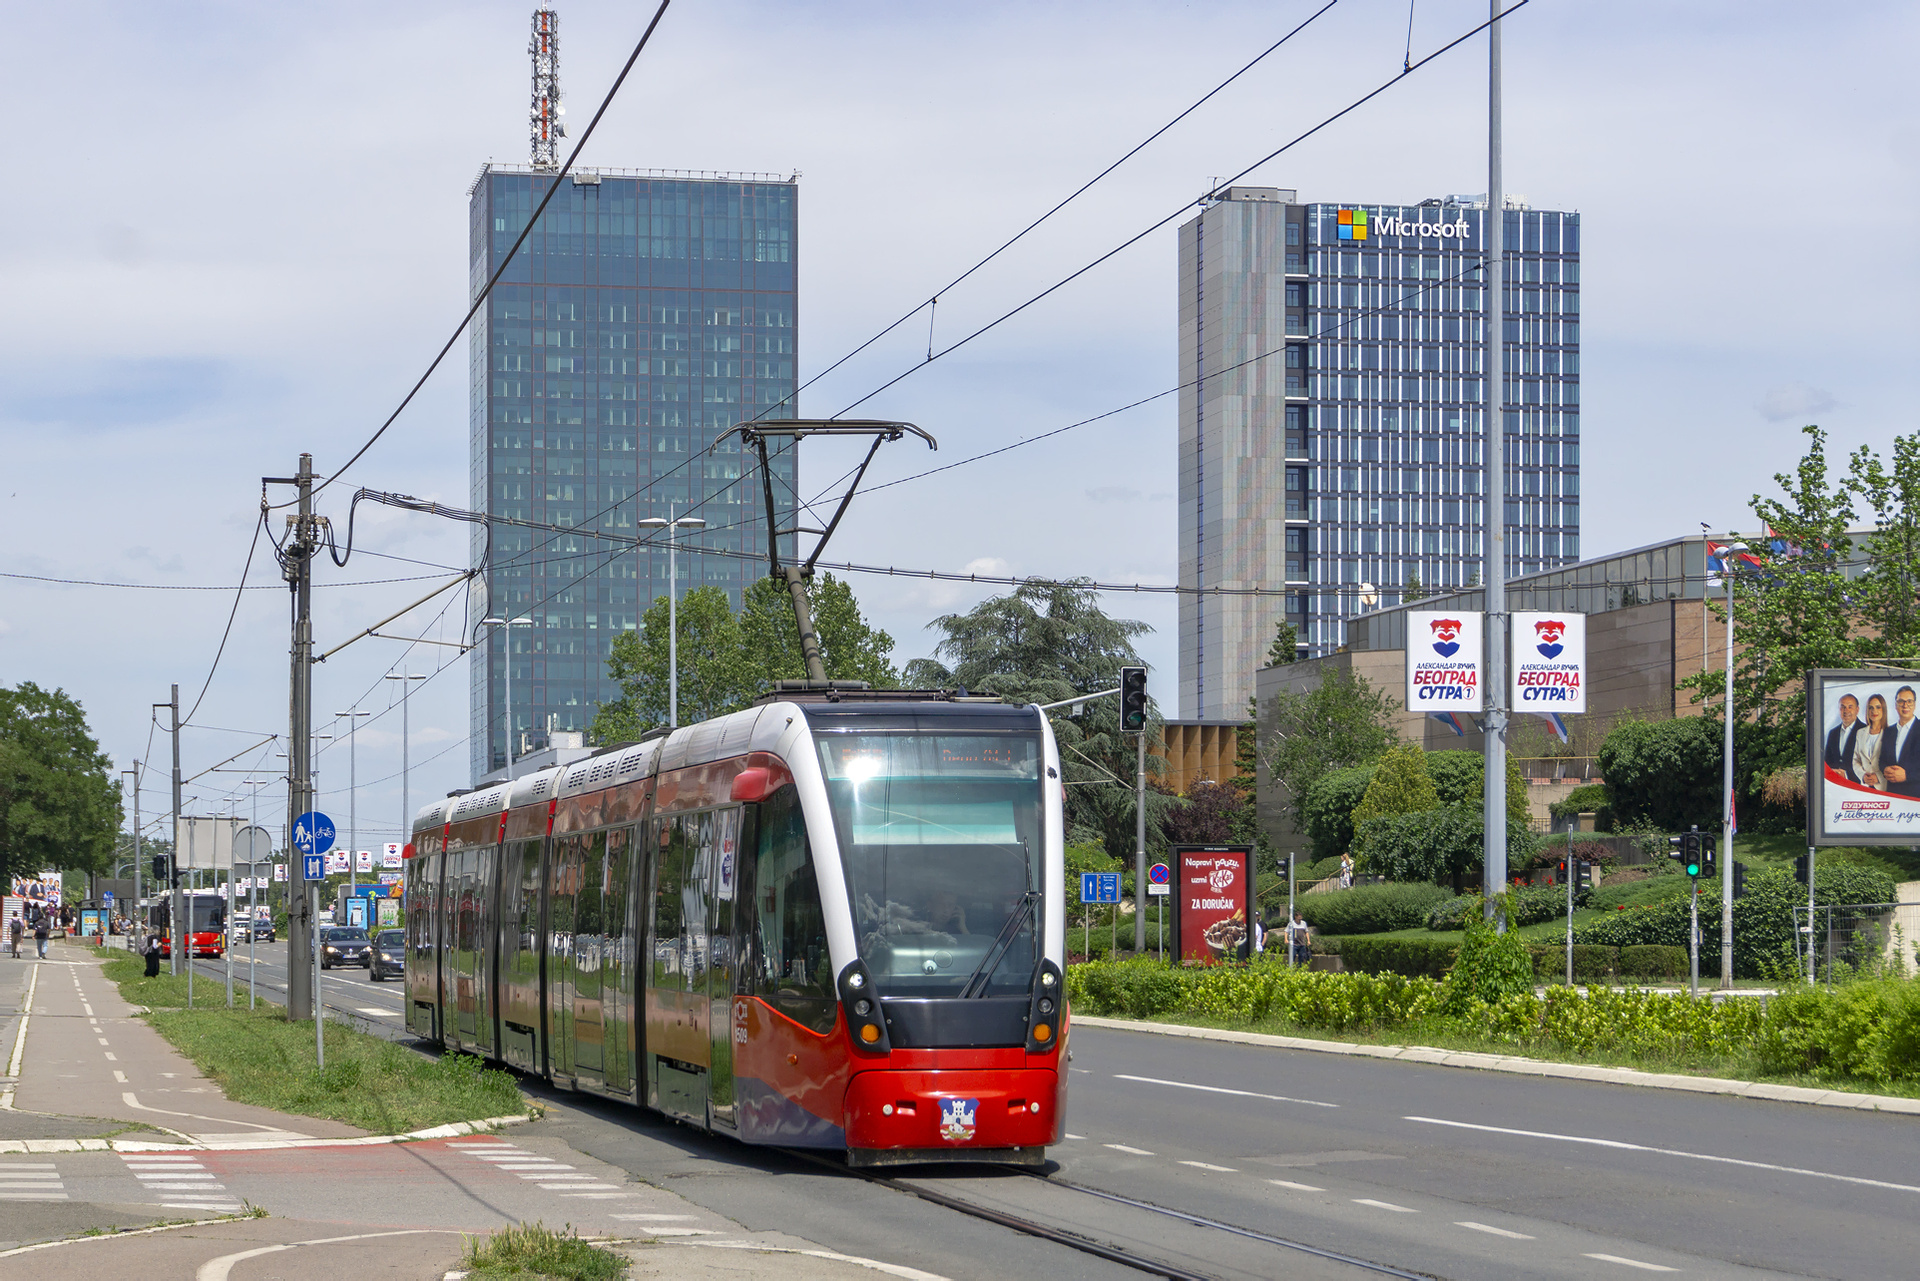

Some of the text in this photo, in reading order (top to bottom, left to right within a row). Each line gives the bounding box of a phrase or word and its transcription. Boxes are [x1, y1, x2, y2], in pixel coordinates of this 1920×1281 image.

[1373, 216, 1470, 239] Microsoft
[1413, 670, 1477, 686] БЕОГРАД
[1517, 672, 1580, 687] БЕОГРАД
[1418, 686, 1462, 700] СУТРА
[1523, 687, 1566, 700] СУТРА
[1185, 858, 1212, 868] Napravi
[1192, 896, 1234, 910] ZA DORUČAK
[736, 1027, 748, 1044] 509
